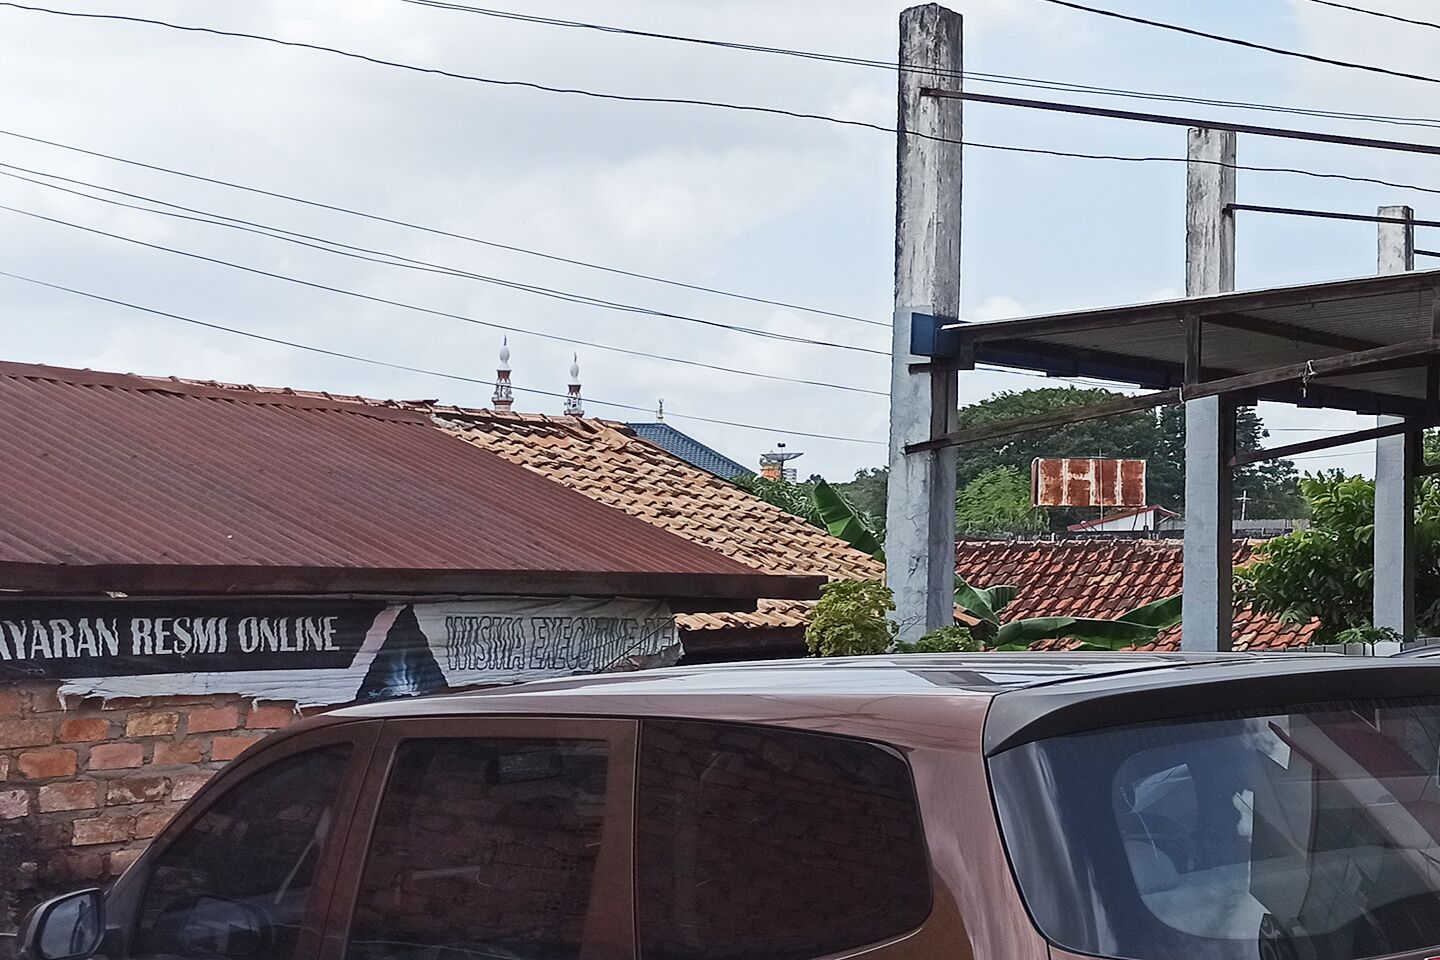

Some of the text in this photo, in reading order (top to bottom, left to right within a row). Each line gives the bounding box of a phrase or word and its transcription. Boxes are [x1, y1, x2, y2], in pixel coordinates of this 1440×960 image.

[131, 616, 228, 657] RESMI
[238, 616, 340, 653] ONLINE
[445, 616, 525, 670] WISMA
